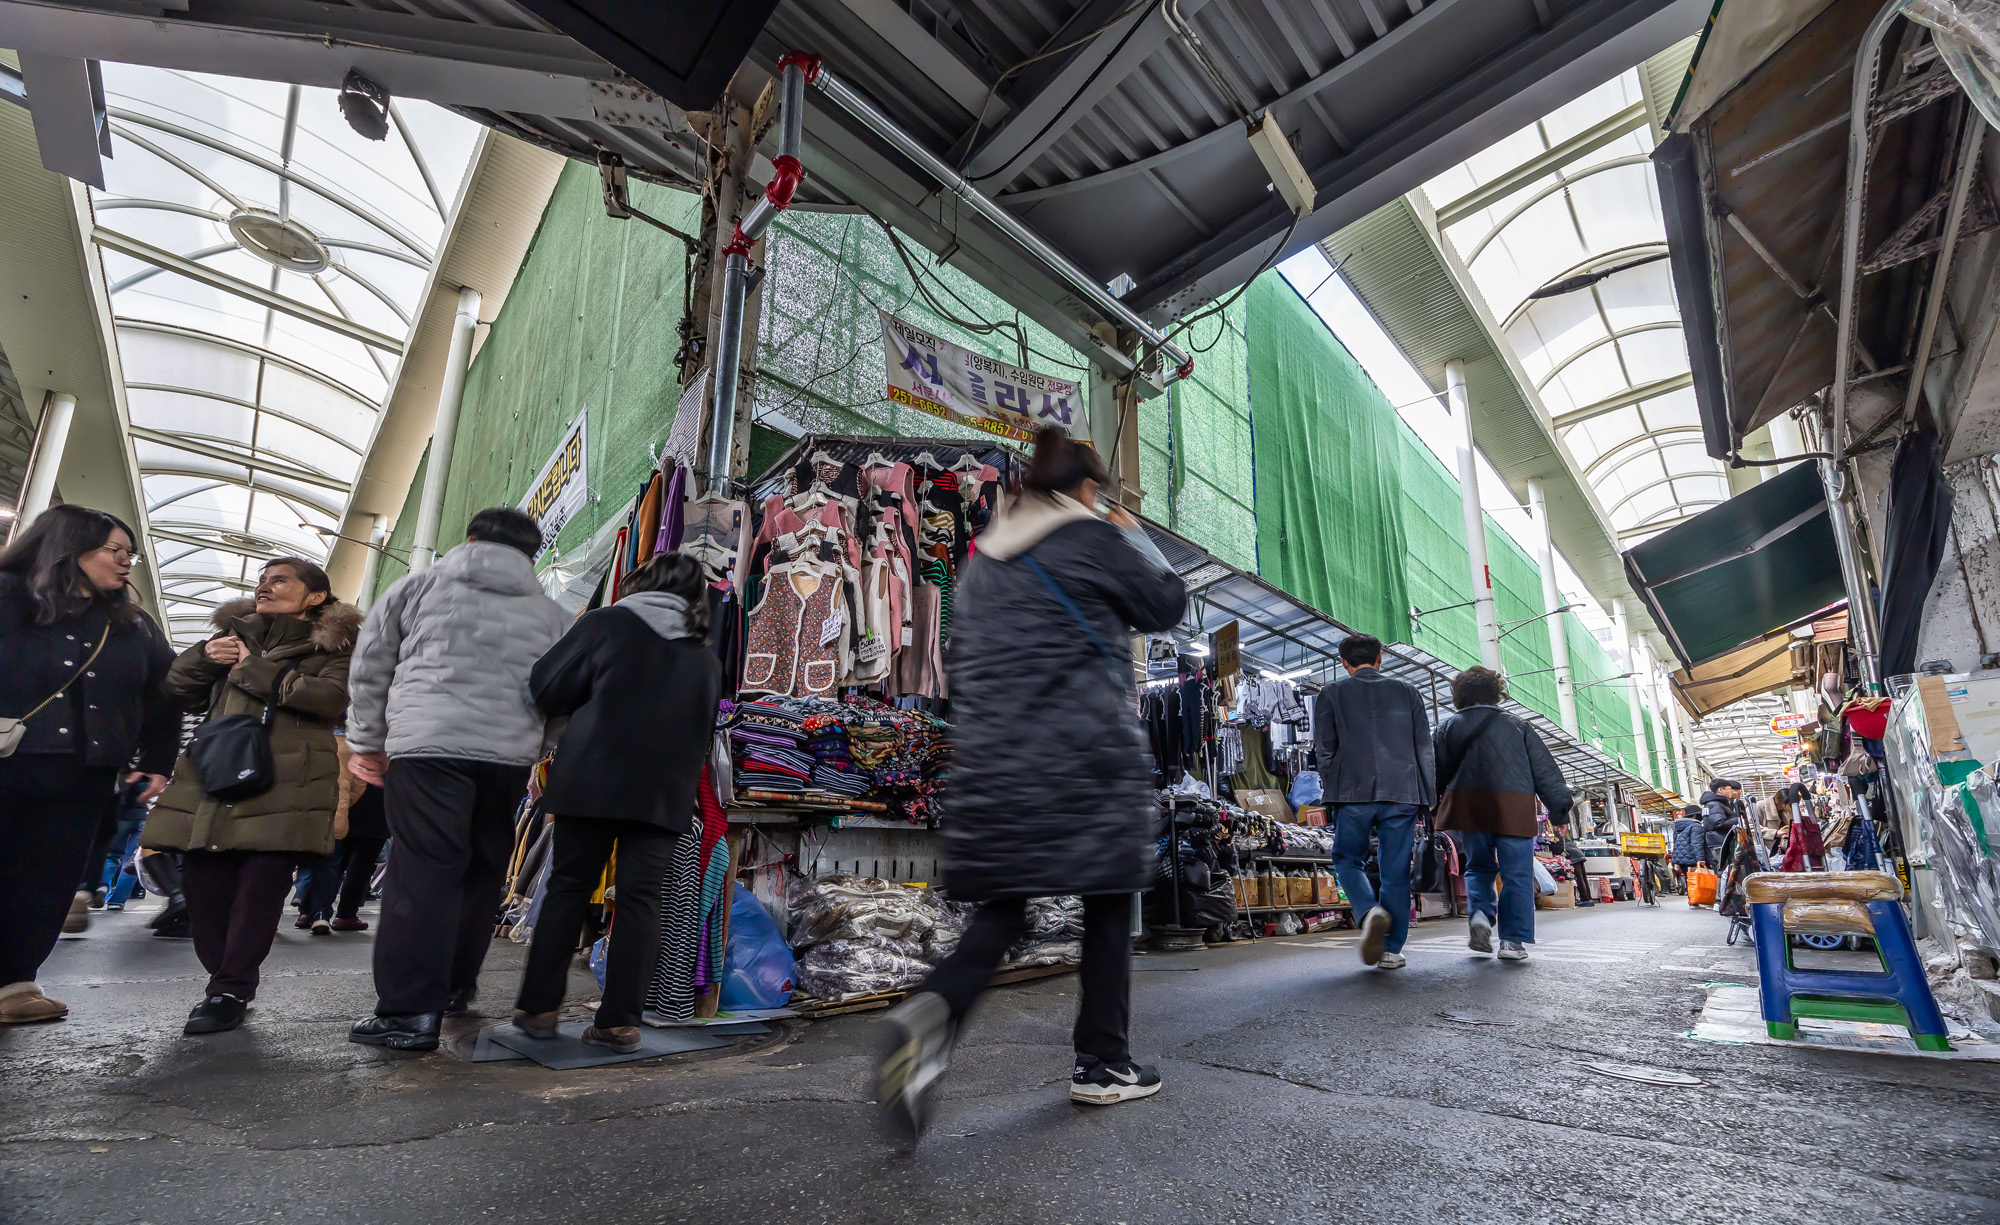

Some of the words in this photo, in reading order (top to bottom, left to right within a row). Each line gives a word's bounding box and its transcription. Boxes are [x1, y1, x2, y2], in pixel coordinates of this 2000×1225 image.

[893, 320, 936, 352] 제일모직
[1010, 369, 1045, 390] 수입원단
[1047, 379, 1072, 396] 전문점
[892, 387, 947, 418] 257-6652
